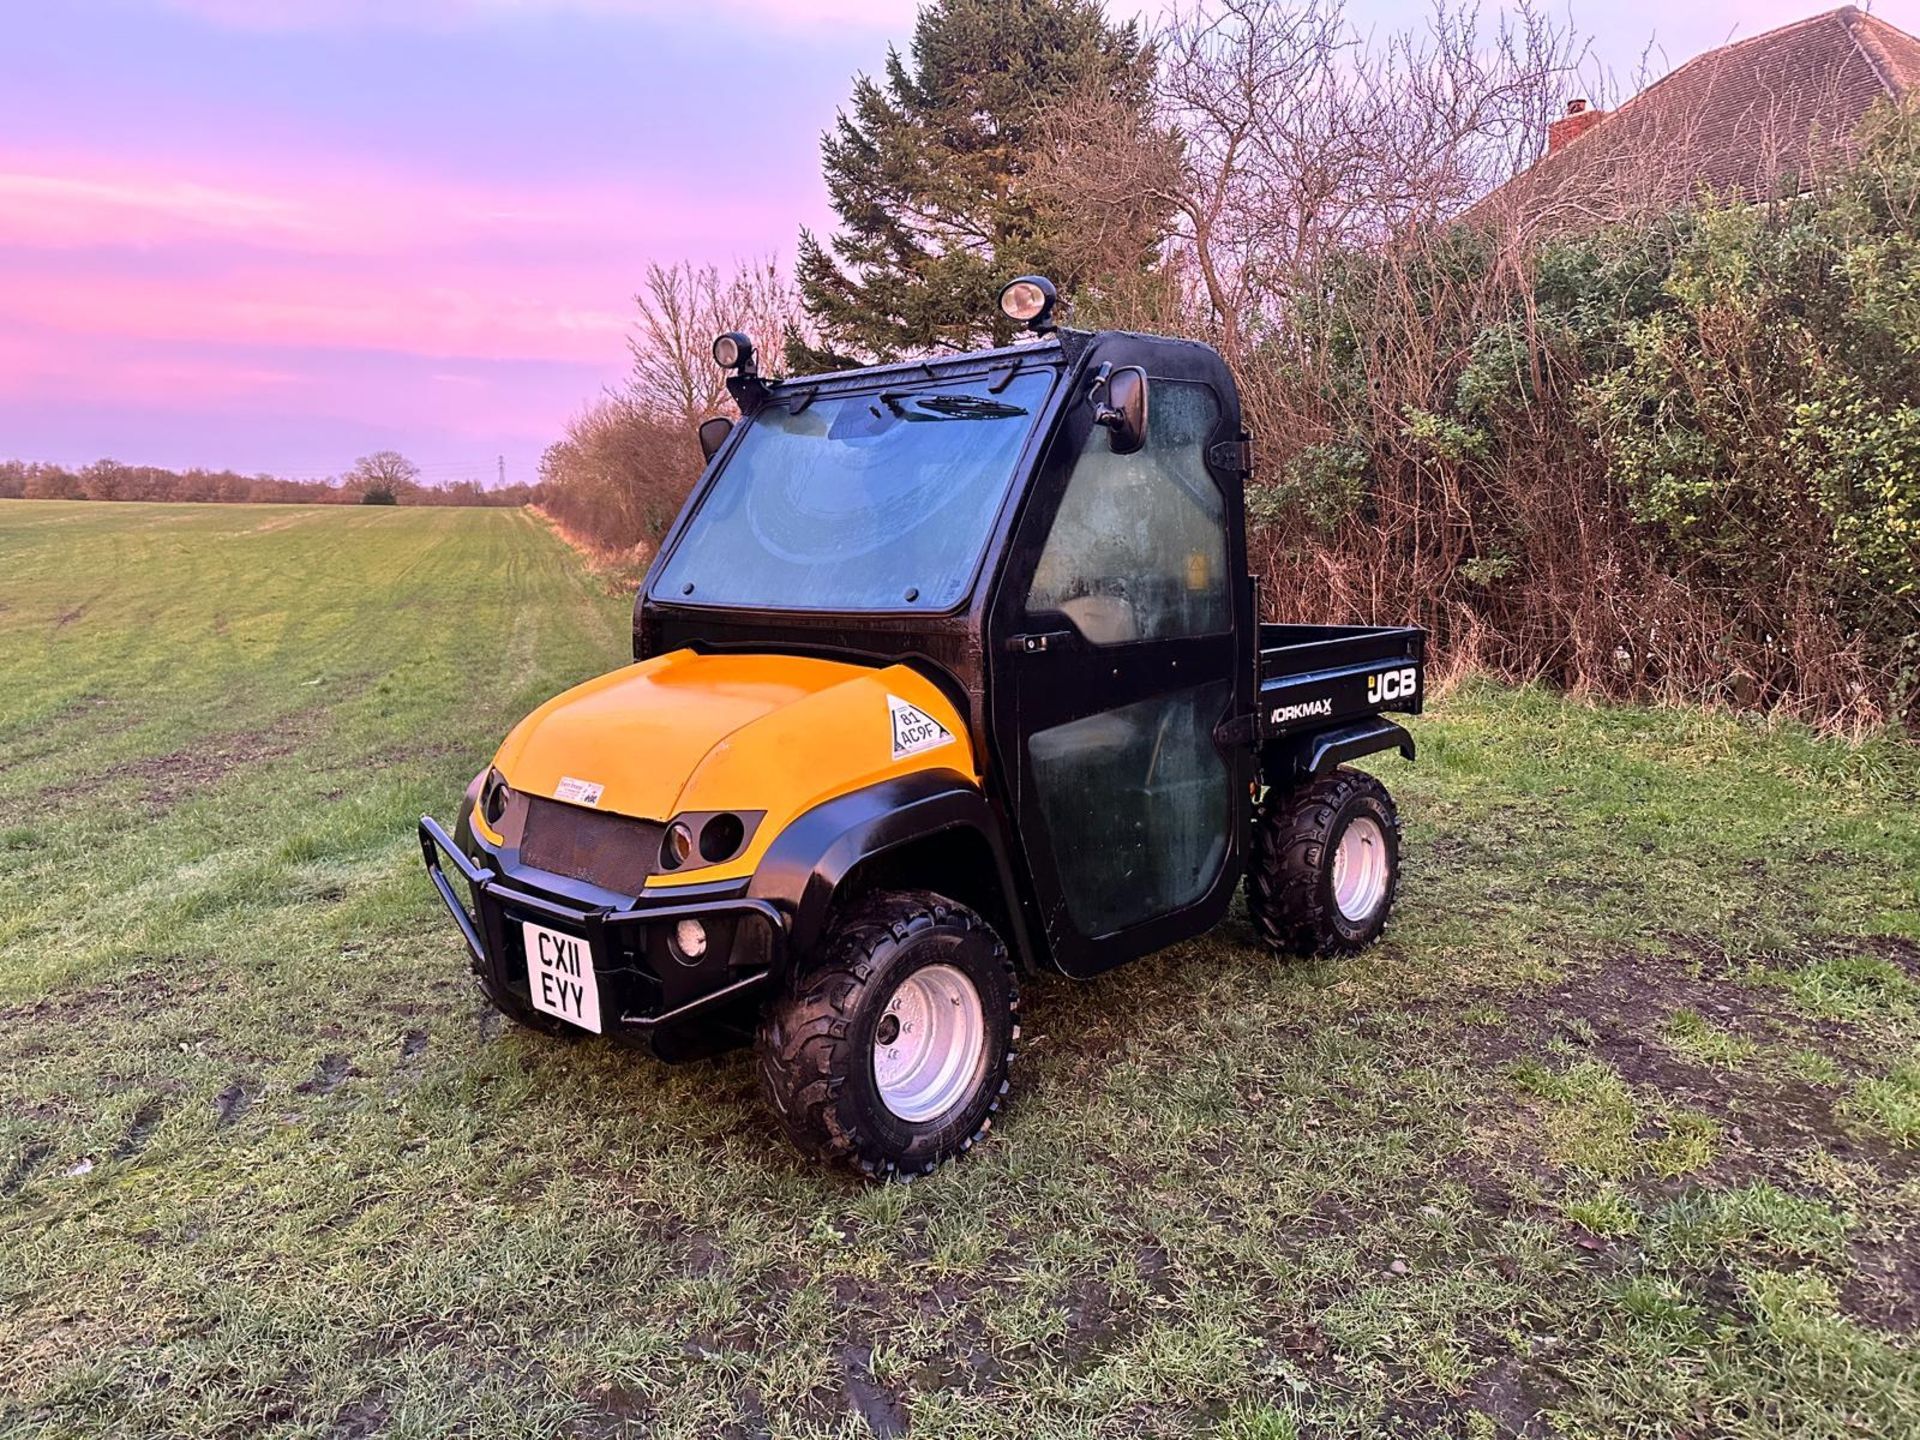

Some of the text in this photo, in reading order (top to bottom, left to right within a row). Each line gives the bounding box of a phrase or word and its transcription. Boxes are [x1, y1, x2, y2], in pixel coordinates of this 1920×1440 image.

[1367, 667, 1417, 704] JCB
[900, 722, 934, 746] AC9F
[538, 931, 581, 978] CX11
[541, 971, 583, 1019] EYY
